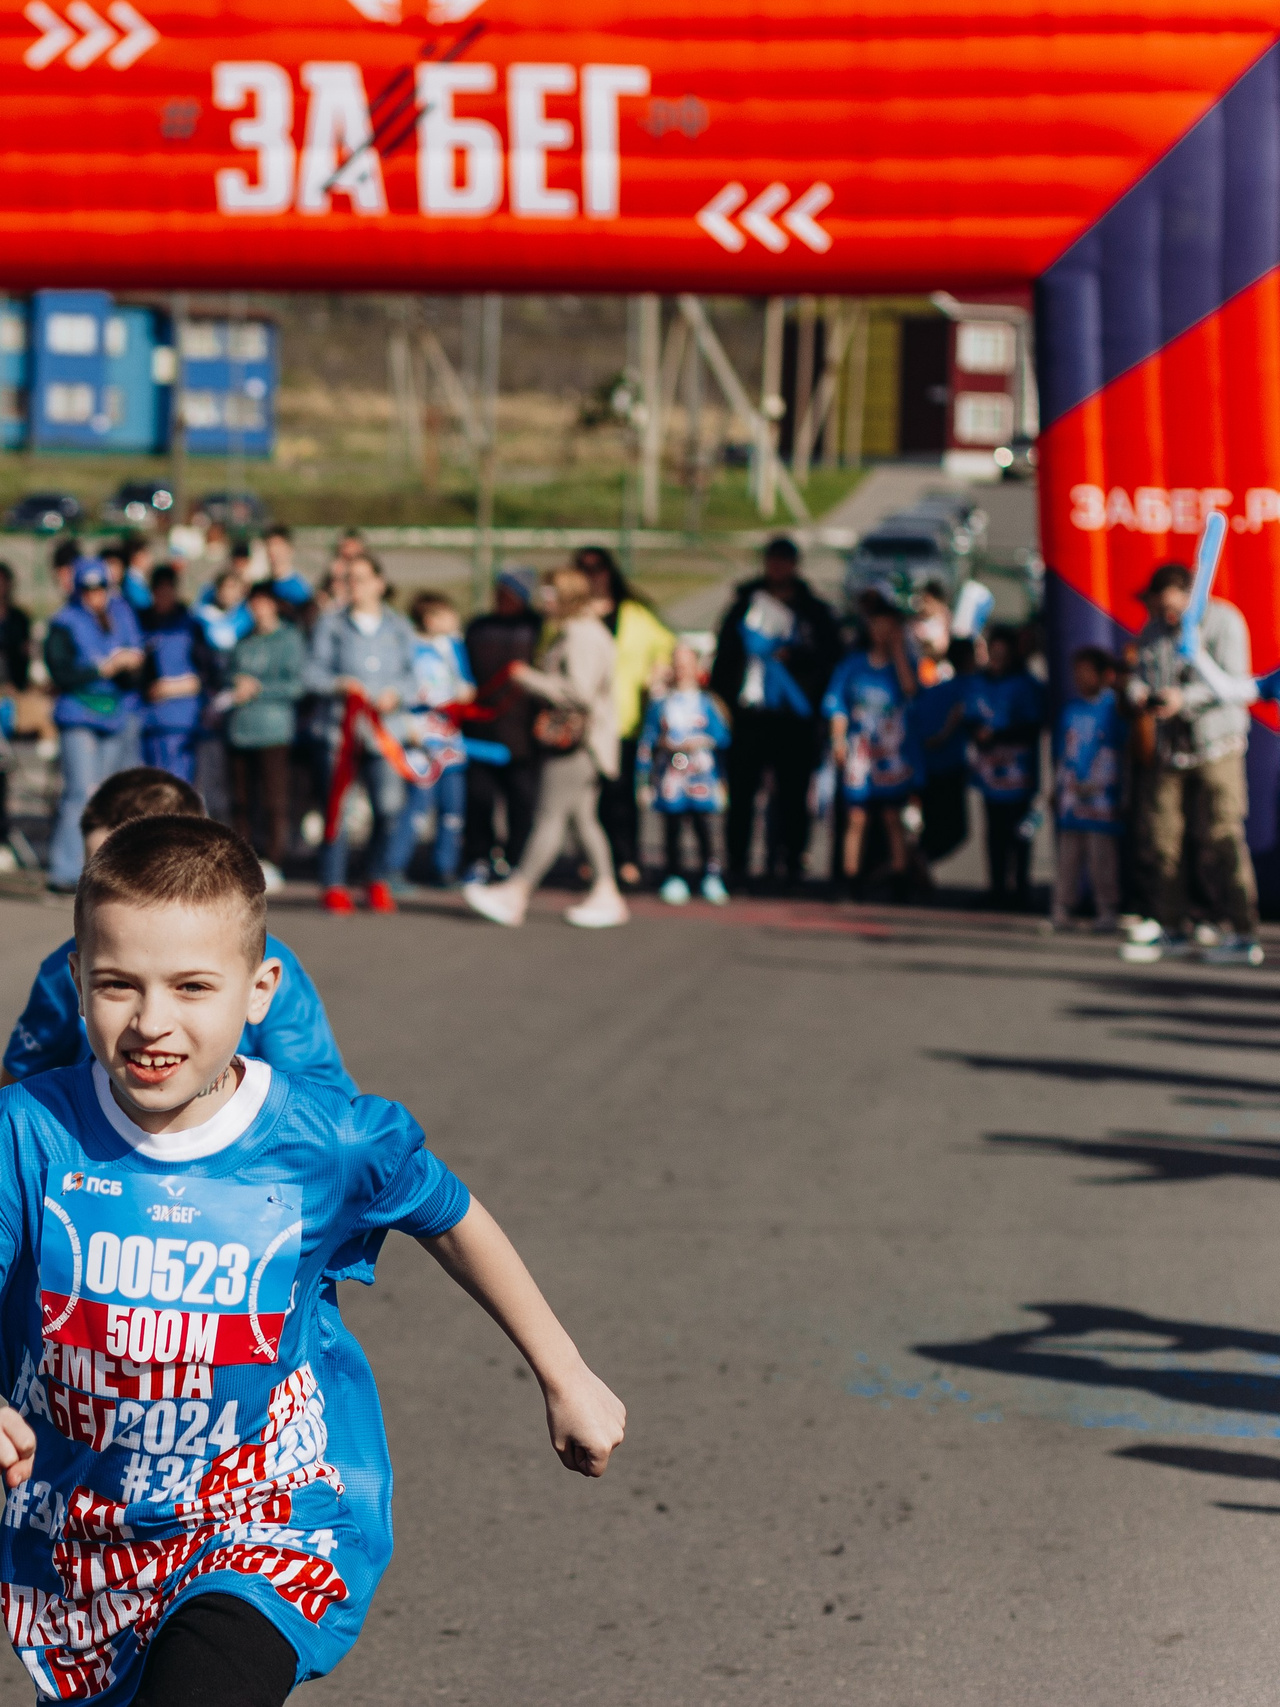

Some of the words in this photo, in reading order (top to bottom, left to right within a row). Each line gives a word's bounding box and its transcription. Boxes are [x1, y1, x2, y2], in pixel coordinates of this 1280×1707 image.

[1071, 485, 1280, 533] ЗАБЕГ.Р
[86, 1176, 123, 1196] ПСБ
[86, 1231, 250, 1306] 00523
[114, 1400, 240, 1456] 2024
